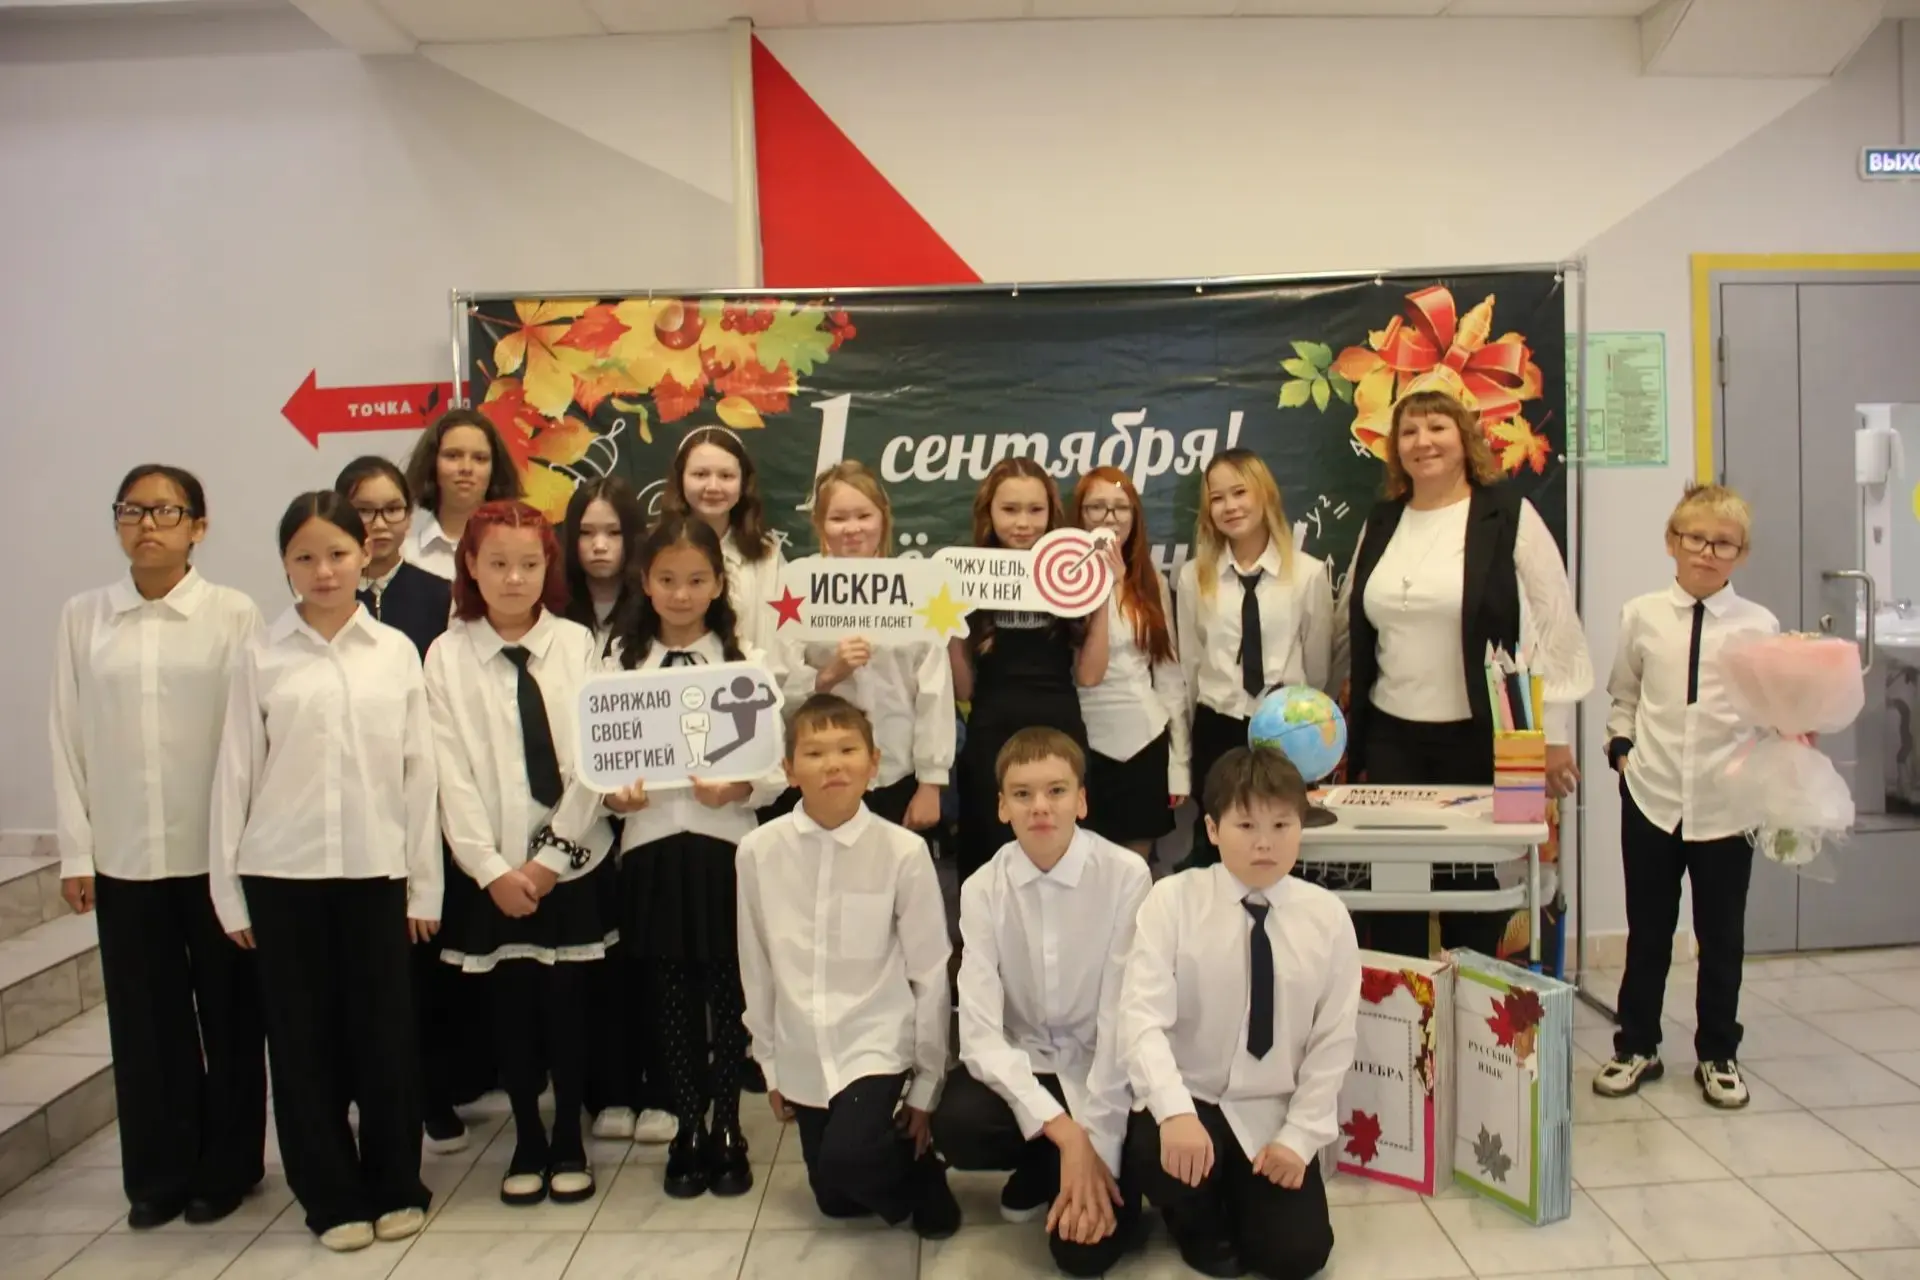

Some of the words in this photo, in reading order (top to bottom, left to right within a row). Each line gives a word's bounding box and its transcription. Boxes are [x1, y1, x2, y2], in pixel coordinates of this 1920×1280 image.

[347, 399, 413, 418] ТОЧКА
[795, 393, 851, 511] 1
[989, 559, 1030, 579] ЦЕЛЬ,
[810, 572, 914, 608] ИСКРА,
[980, 582, 989, 599] К
[993, 580, 1021, 601] НЕЙ
[810, 615, 857, 629] КОТОРАЯ
[859, 615, 872, 629] НЕ
[874, 615, 913, 629] ГАСНЕТ
[590, 690, 671, 713] ЗАРЯЖАЮ
[591, 717, 643, 743] СВОЕЙ
[593, 744, 675, 772] ЭНЕРГИЕЙ
[1468, 1040, 1512, 1066] РУССКИЙ
[1348, 1059, 1404, 1081] ЛГЕБРА
[1478, 1061, 1503, 1080] ЯЗЫК
